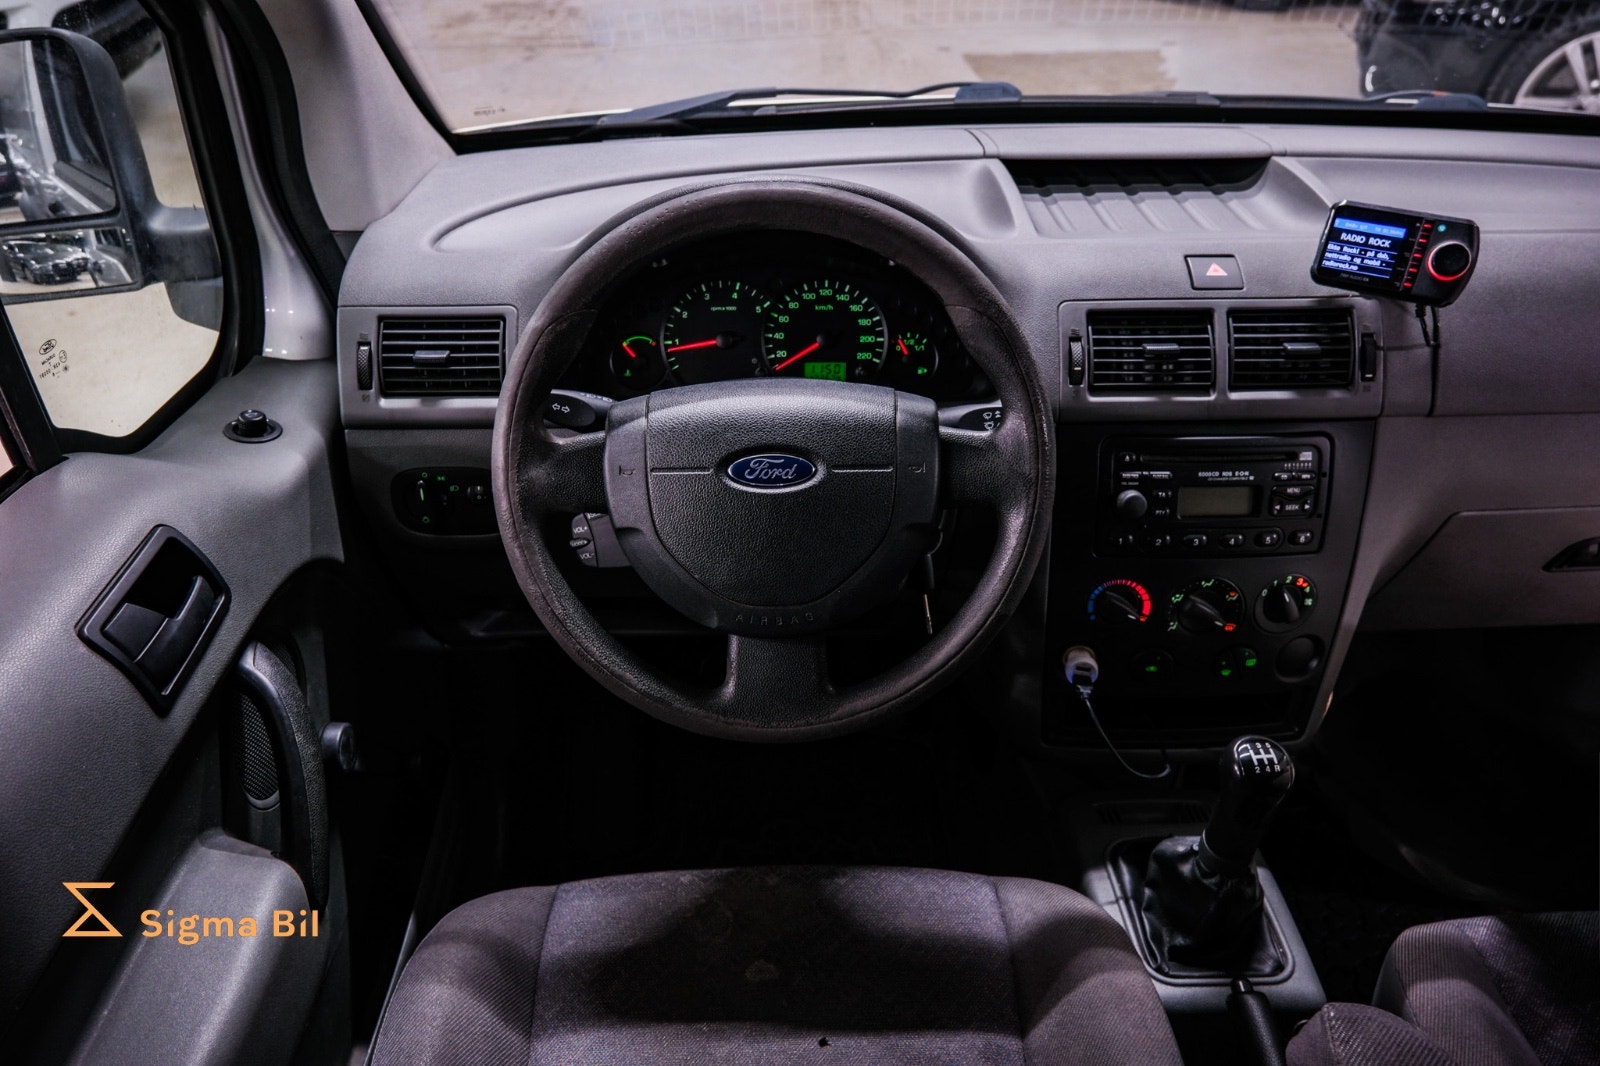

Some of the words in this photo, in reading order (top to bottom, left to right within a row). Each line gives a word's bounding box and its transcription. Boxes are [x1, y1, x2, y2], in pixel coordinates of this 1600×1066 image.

[1340, 232, 1366, 244] RADIO
[1368, 237, 1392, 248] ROCK
[744, 458, 797, 480] Ford
[1296, 577, 1303, 585] 3
[734, 612, 816, 626] AIRBAG
